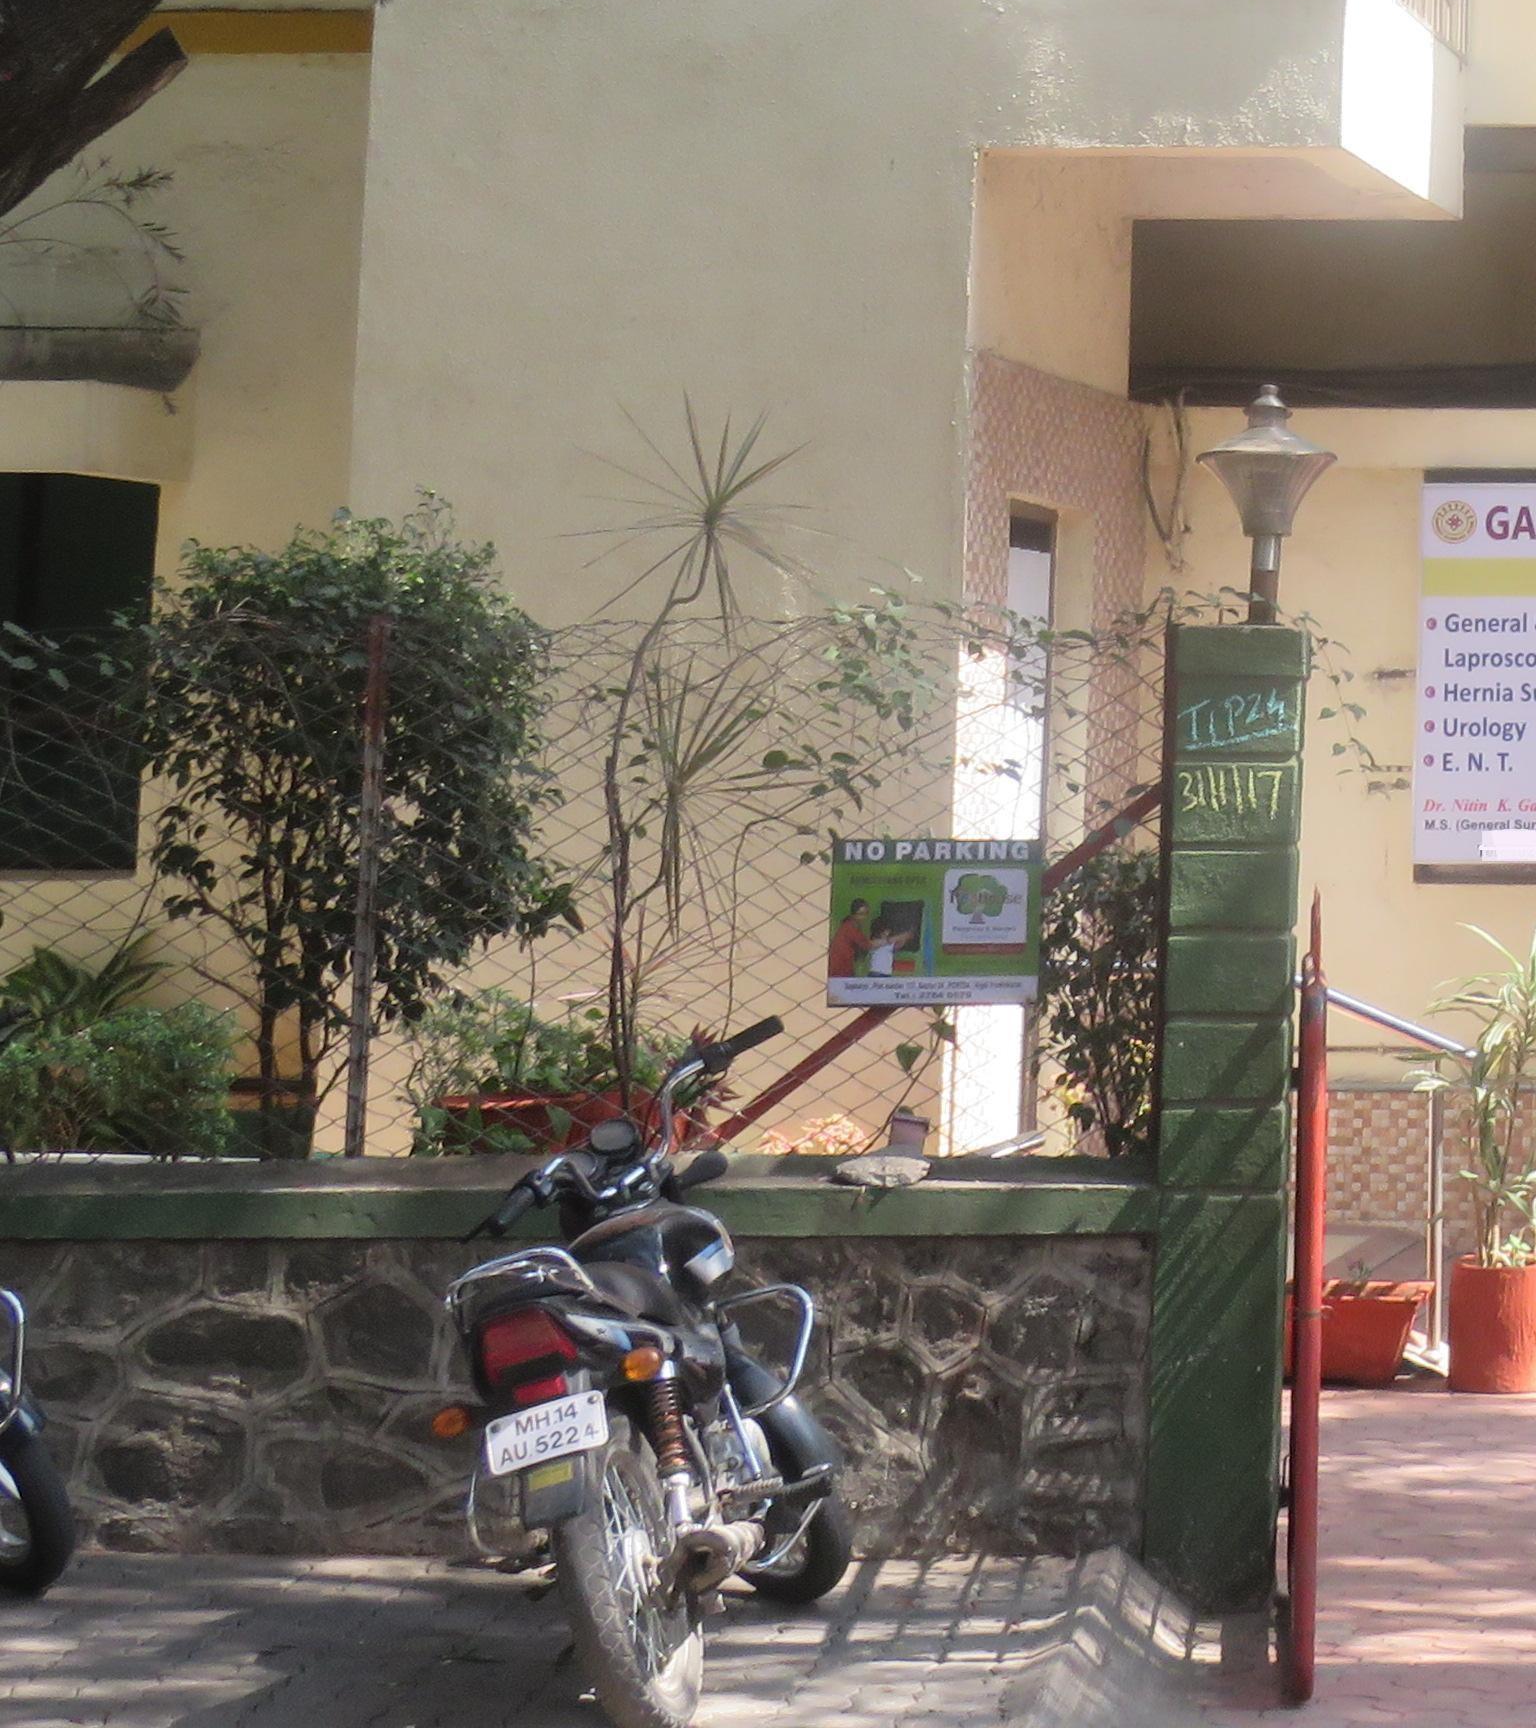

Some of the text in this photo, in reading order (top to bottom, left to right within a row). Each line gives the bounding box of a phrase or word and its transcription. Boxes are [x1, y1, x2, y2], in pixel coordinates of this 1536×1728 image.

[1444, 612, 1528, 633] General
[1443, 683, 1514, 703] Hernia
[1443, 717, 1527, 742] Urology
[1442, 753, 1513, 772] E. N. T.
[1423, 799, 1445, 812] Dr.
[1453, 799, 1488, 812] Nitin
[1496, 799, 1512, 812] K.
[1424, 820, 1451, 830] M.S.
[1456, 820, 1510, 831] (General
[844, 841, 1029, 861] NO PARKING
